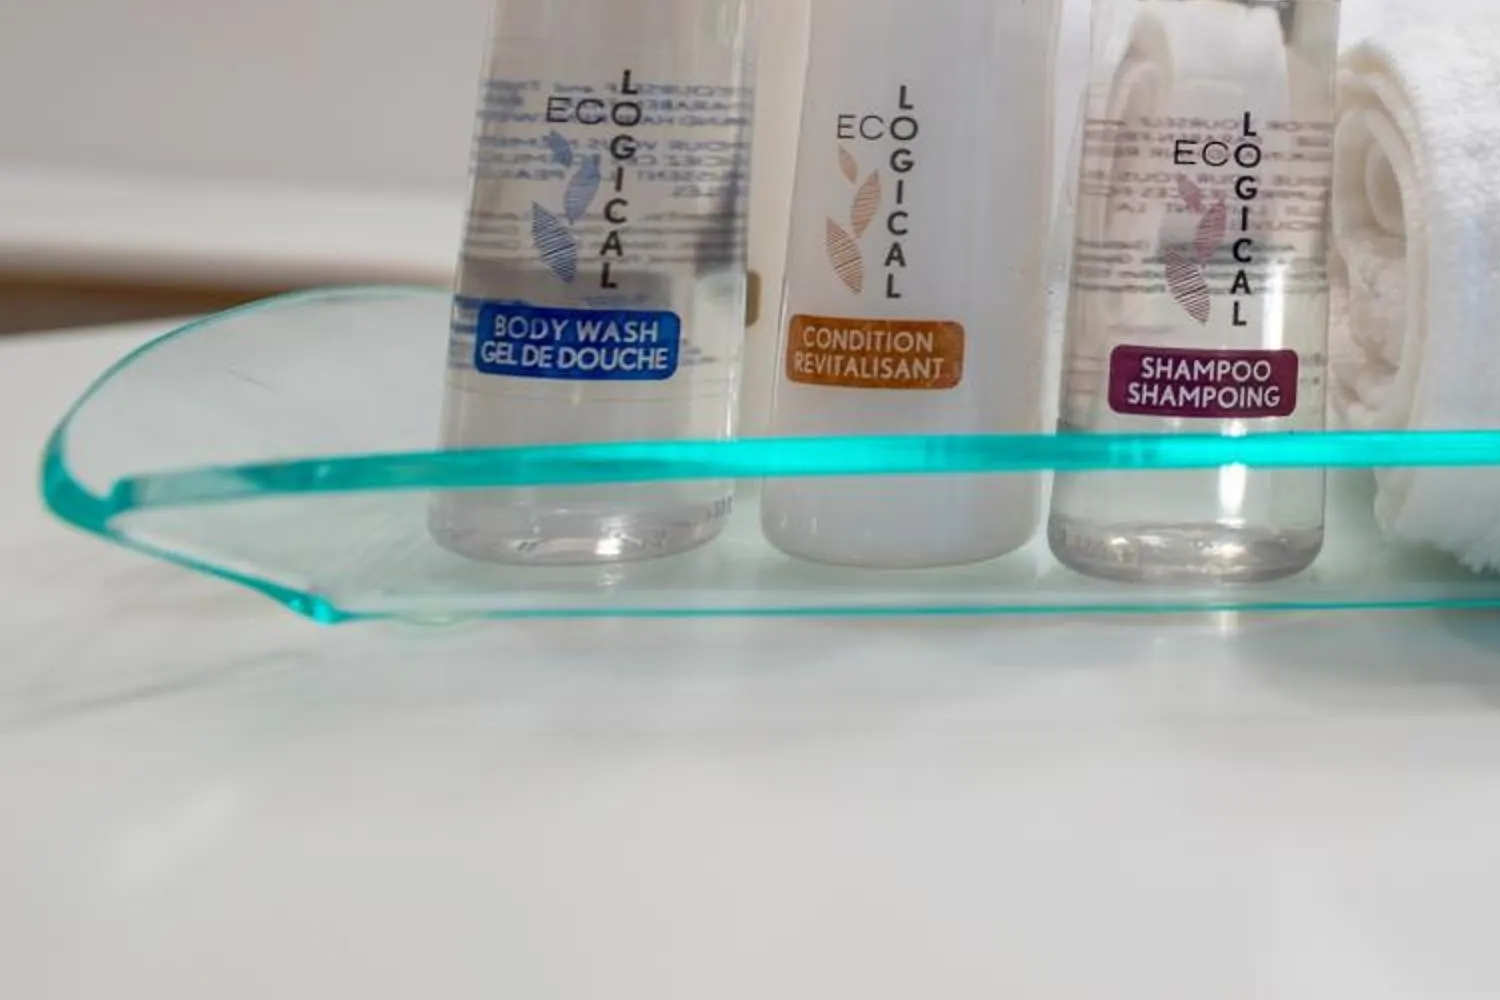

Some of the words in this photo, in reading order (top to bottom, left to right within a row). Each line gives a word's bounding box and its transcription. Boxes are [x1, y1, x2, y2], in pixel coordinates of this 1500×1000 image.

[599, 69, 642, 289] LOGICAL
[884, 85, 919, 299] LOGICAL
[1230, 111, 1262, 326] LOGICAL
[495, 314, 570, 341] BODY
[576, 319, 659, 343] WASH
[803, 326, 934, 353] CONDITION
[480, 340, 518, 365] GEL
[521, 344, 554, 368] DE
[556, 346, 669, 371] DOUCHE
[794, 351, 945, 380] REVITALISANT
[1141, 356, 1272, 382] SHAMPOO
[1127, 382, 1281, 409] SHAMPOING
